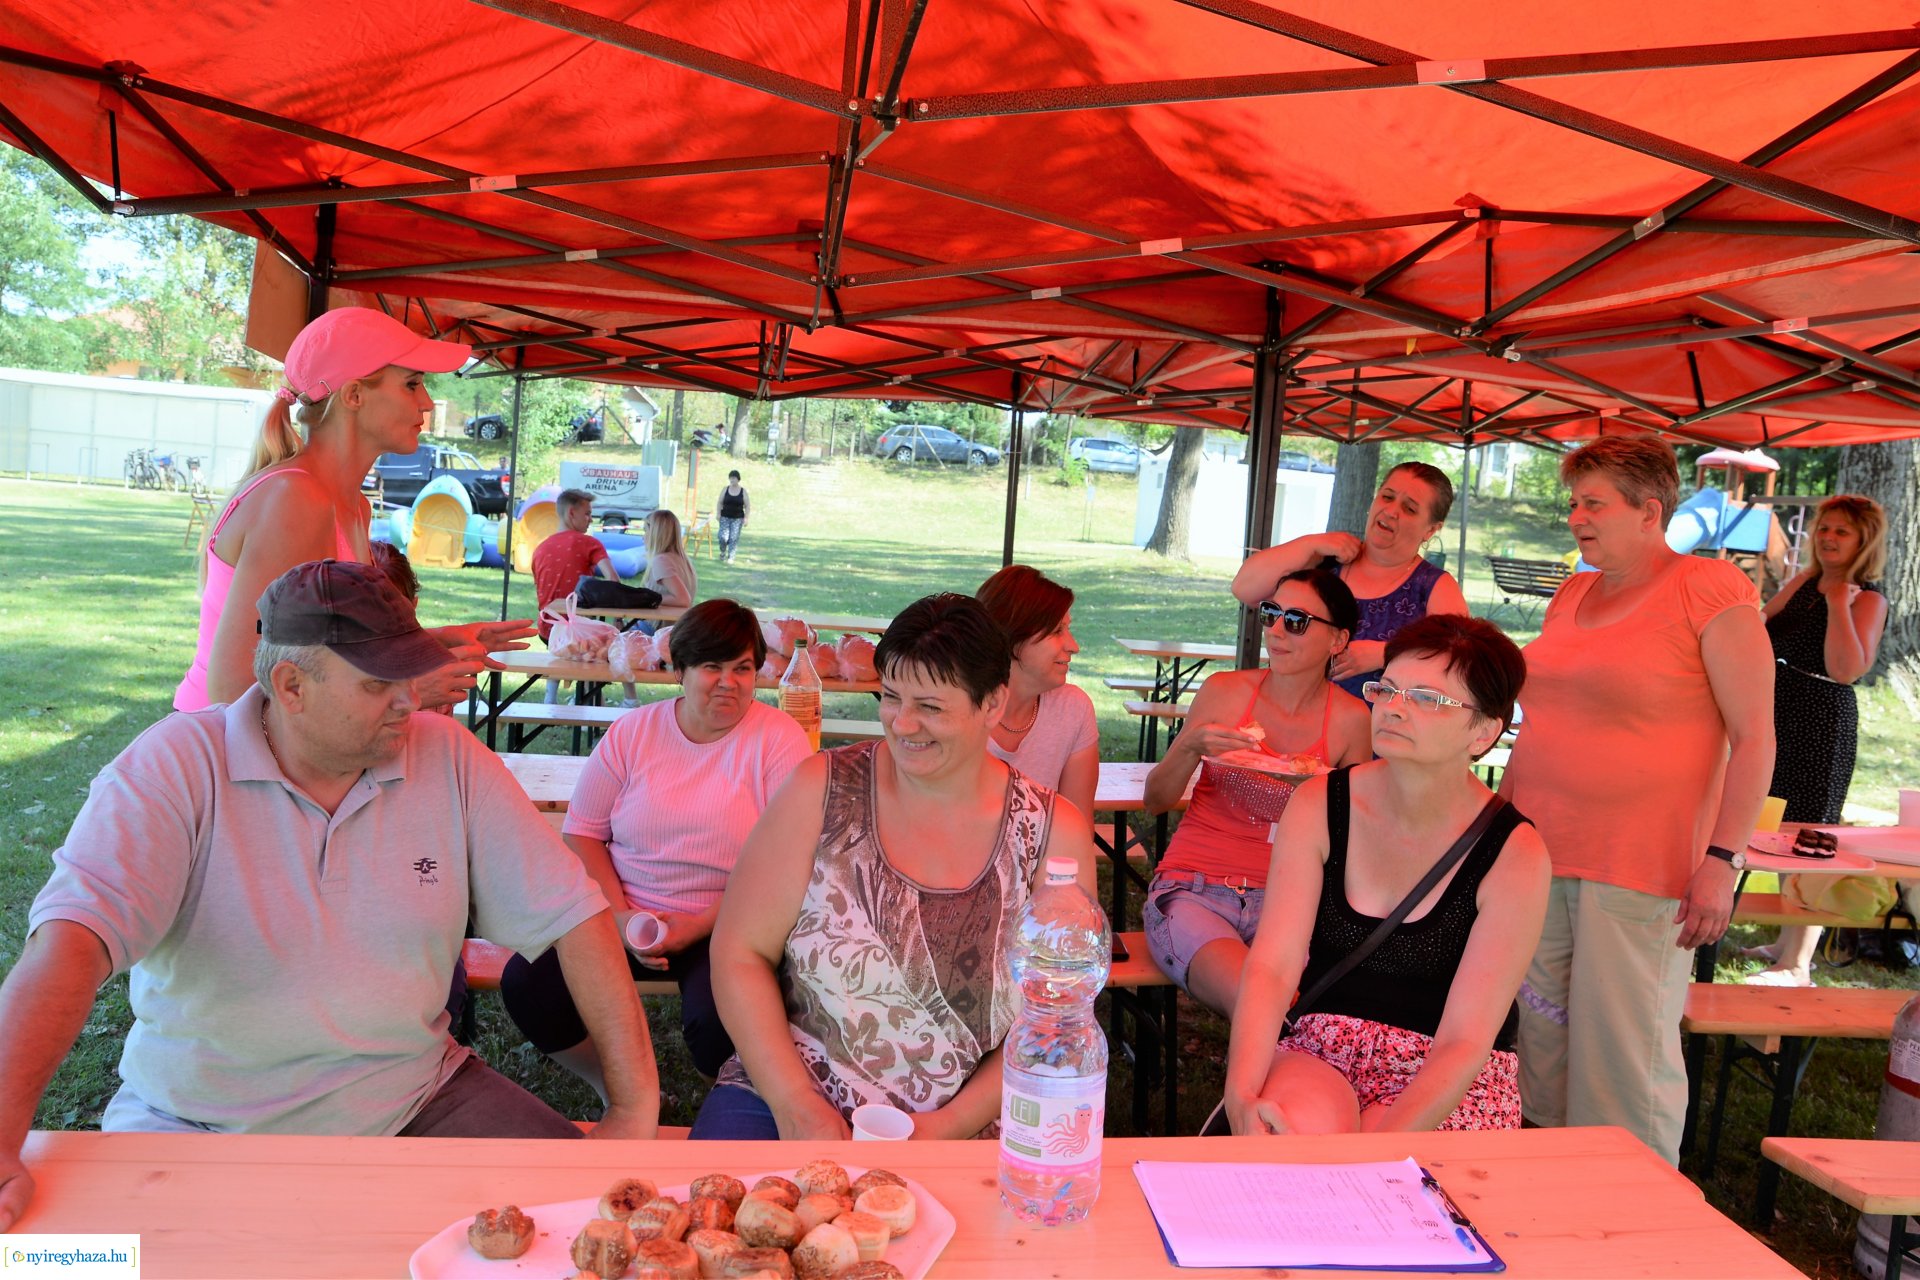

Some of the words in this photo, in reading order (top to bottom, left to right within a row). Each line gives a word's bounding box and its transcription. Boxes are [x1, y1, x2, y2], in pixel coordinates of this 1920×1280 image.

[589, 468, 639, 479] BAUHAUS
[585, 483, 617, 491] ARENA
[595, 478, 638, 487] DRIVE-IN
